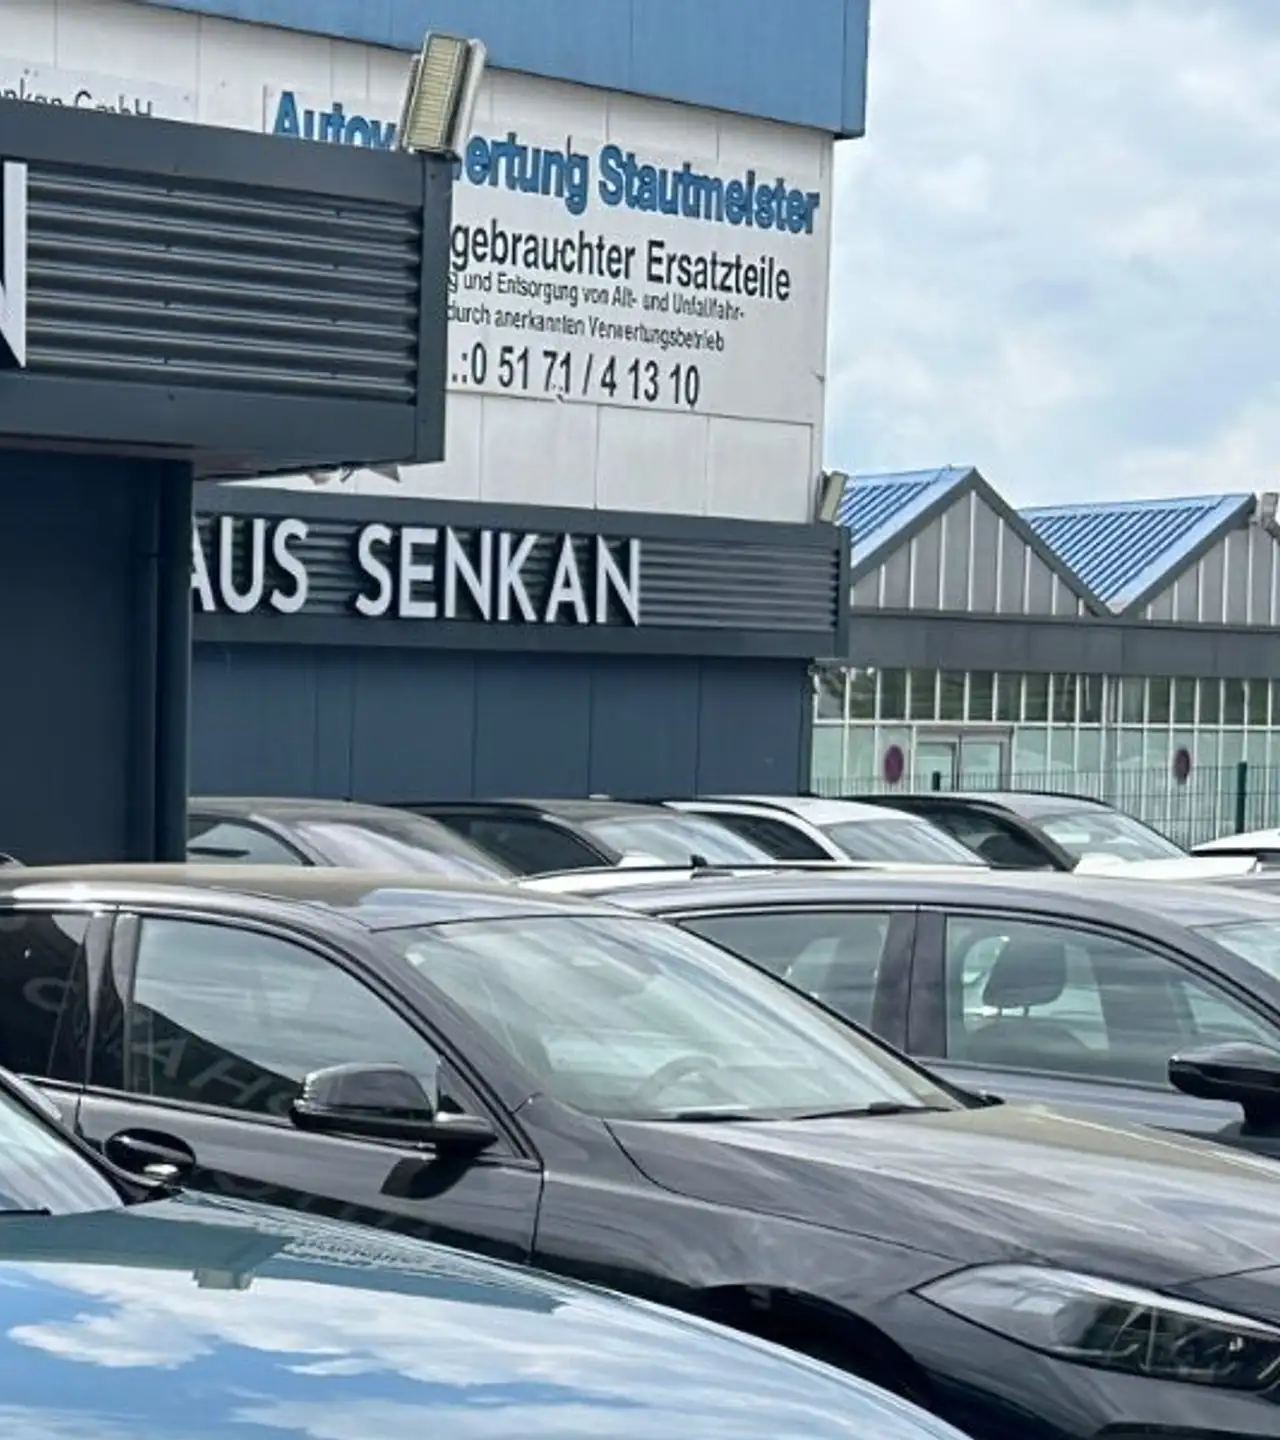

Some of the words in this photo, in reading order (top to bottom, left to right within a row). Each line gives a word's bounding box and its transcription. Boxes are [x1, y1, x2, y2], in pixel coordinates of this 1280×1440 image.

[598, 143, 820, 235] Stautmeister
[451, 217, 636, 281] gebrauchter
[646, 239, 791, 301] Ersatzteile
[463, 272, 492, 292] und
[497, 272, 578, 308] Entsorgung
[582, 287, 609, 304] von
[611, 285, 638, 309] Alt-
[643, 292, 669, 313] und
[601, 356, 617, 397] 4
[628, 357, 659, 402] 13
[670, 364, 700, 406] 10
[356, 524, 640, 626] SENKAN
